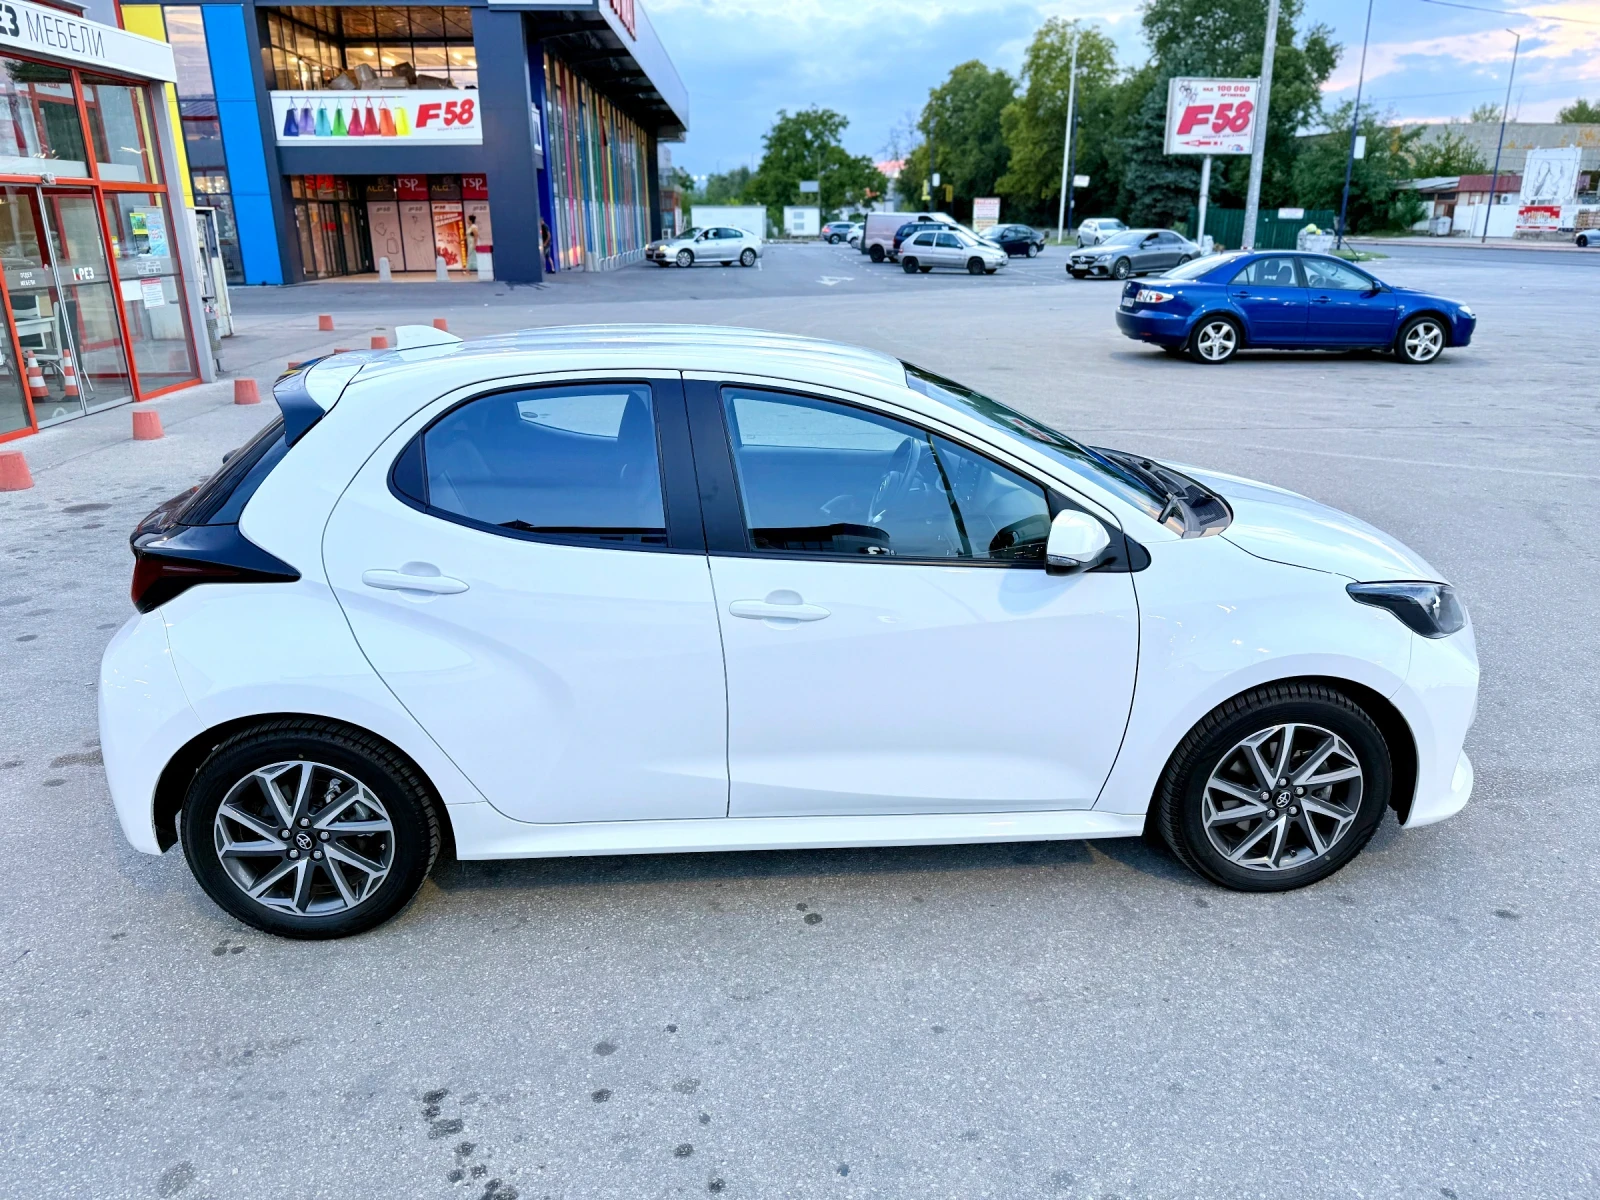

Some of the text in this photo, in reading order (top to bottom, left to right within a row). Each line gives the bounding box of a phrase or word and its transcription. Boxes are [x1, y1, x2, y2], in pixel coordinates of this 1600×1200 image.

[25, 10, 105, 59] МЕБЕЛИ
[397, 178, 419, 191] rsp
[462, 177, 483, 191] rsp
